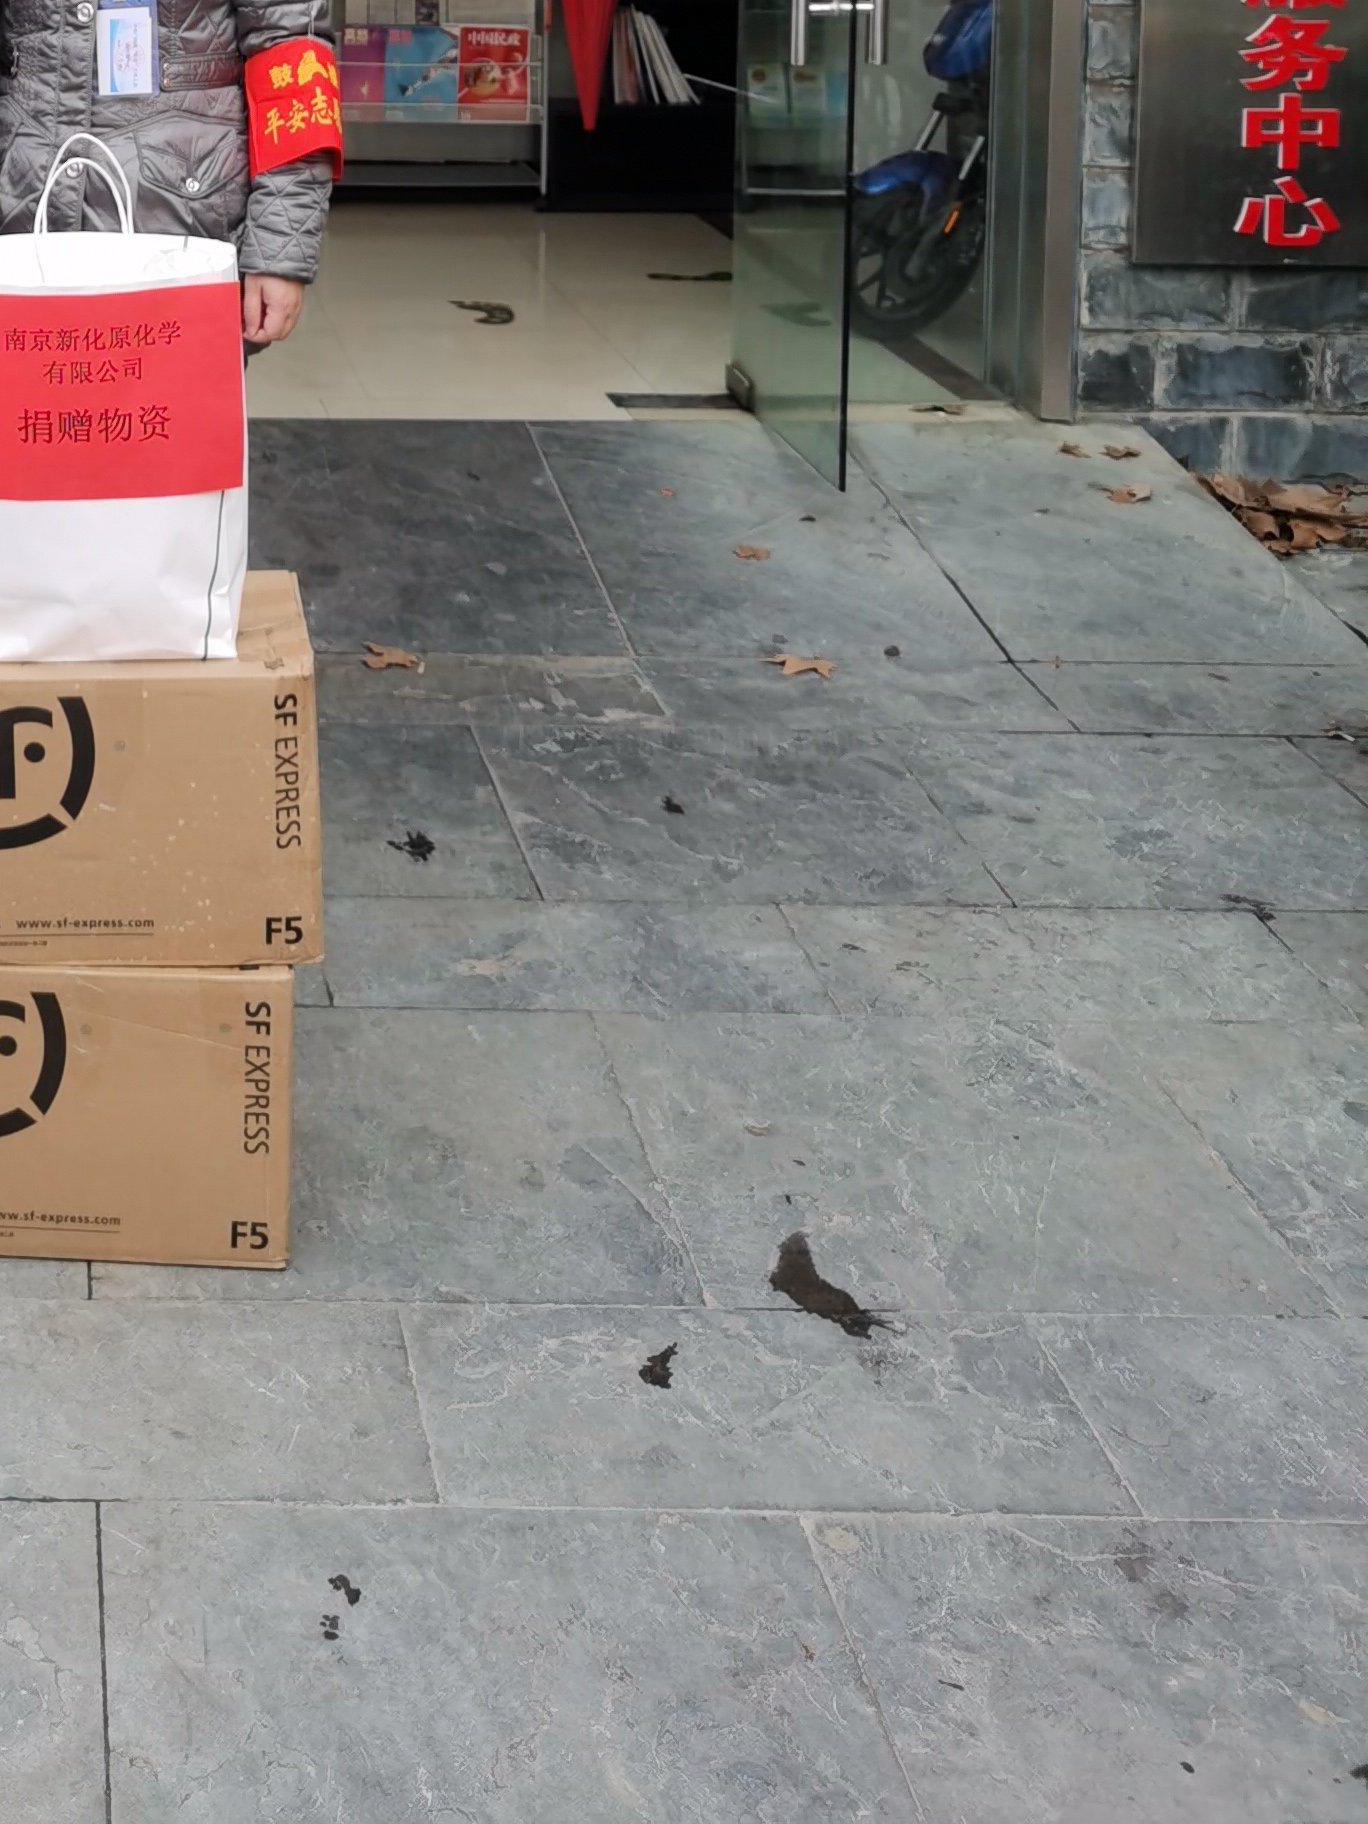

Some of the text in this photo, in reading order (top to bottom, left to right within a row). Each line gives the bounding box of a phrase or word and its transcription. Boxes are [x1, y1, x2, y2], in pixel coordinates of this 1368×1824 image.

[3, 320, 181, 352] 南京新化原化学
[42, 357, 143, 385] 有限公司
[17, 403, 172, 446] 捐赠物资
[273, 694, 302, 850] SF EXPRESS
[16, 918, 154, 930] www.sf-express.com
[265, 917, 304, 945] F5
[243, 1001, 272, 1156] SF EXPRESS
[230, 1221, 270, 1250] F5
